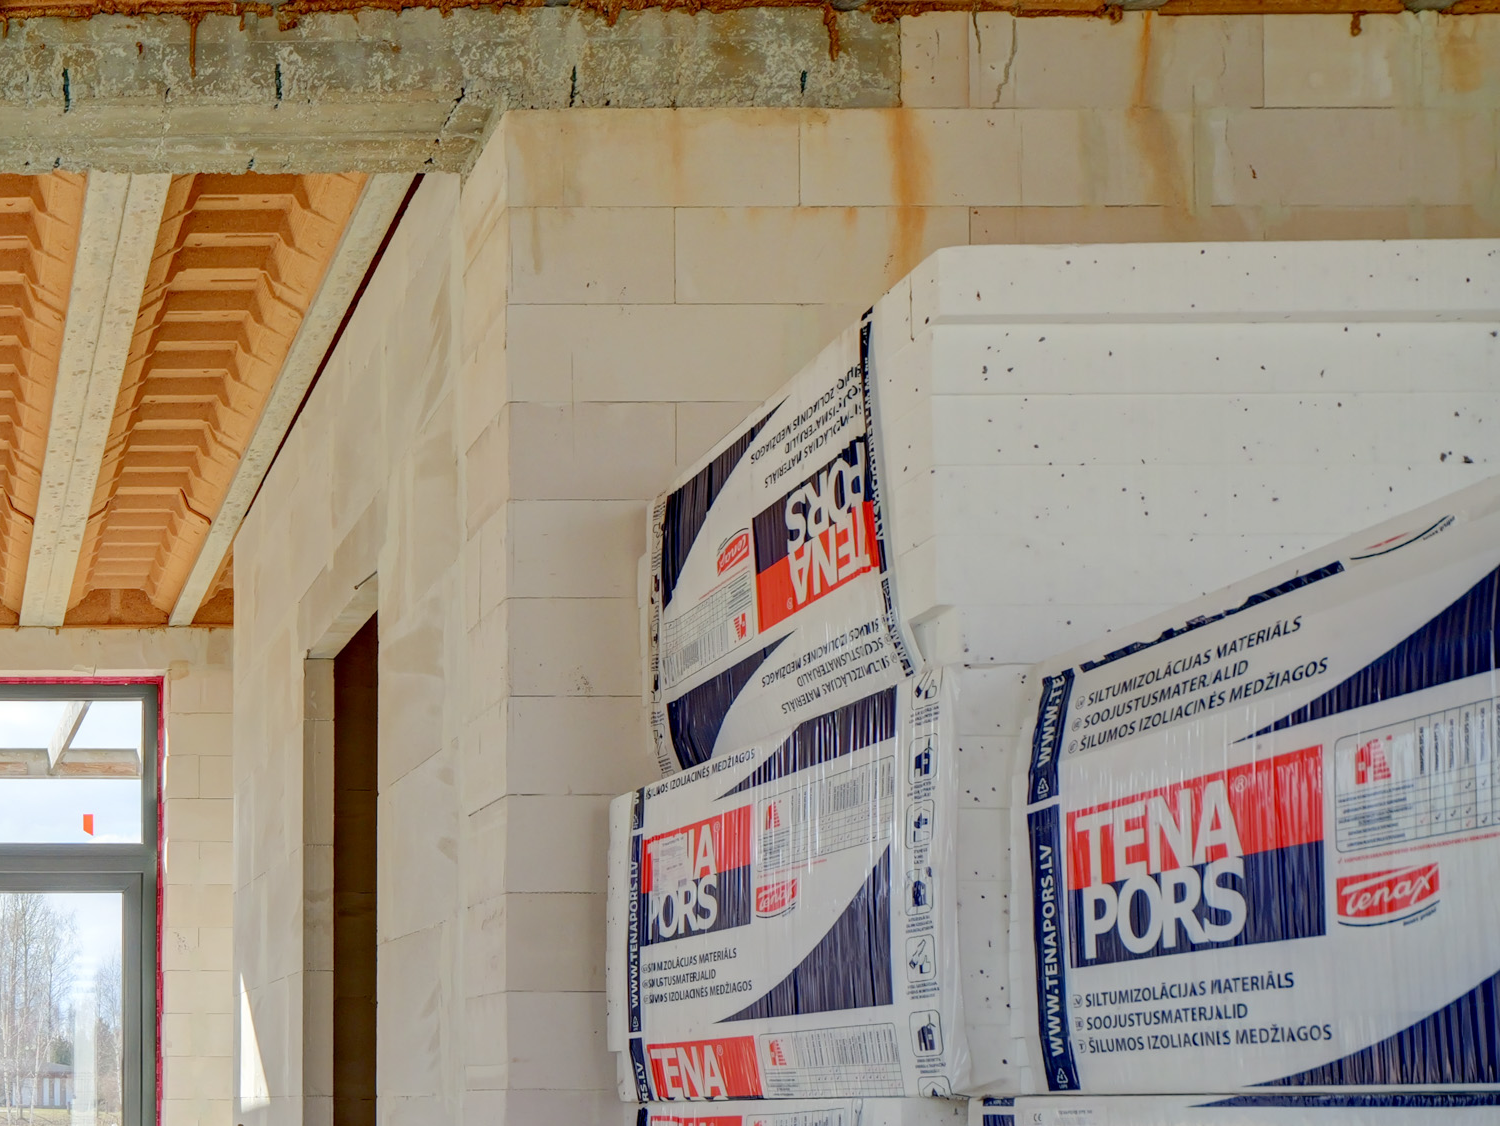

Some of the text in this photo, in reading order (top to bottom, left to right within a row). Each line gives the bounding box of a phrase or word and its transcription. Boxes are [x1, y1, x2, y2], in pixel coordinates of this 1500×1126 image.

[785, 441, 867, 547] PORS
[787, 507, 870, 605] TENA
[1079, 719, 1138, 752] ŠILUMOS
[1229, 656, 1329, 704] MEDŽIAGOS
[1087, 616, 1302, 708] SILTUMIZOLĀCIJAS MATERIĀLS
[1075, 779, 1244, 888] TENA
[1039, 844, 1064, 1057] WWW.TENAPORS.LV
[1083, 857, 1248, 960] PORS
[650, 1044, 729, 1099] TENA
[1089, 1033, 1143, 1054] ŠILUMOS
[1235, 1023, 1333, 1046] MEDŽIAGOS
